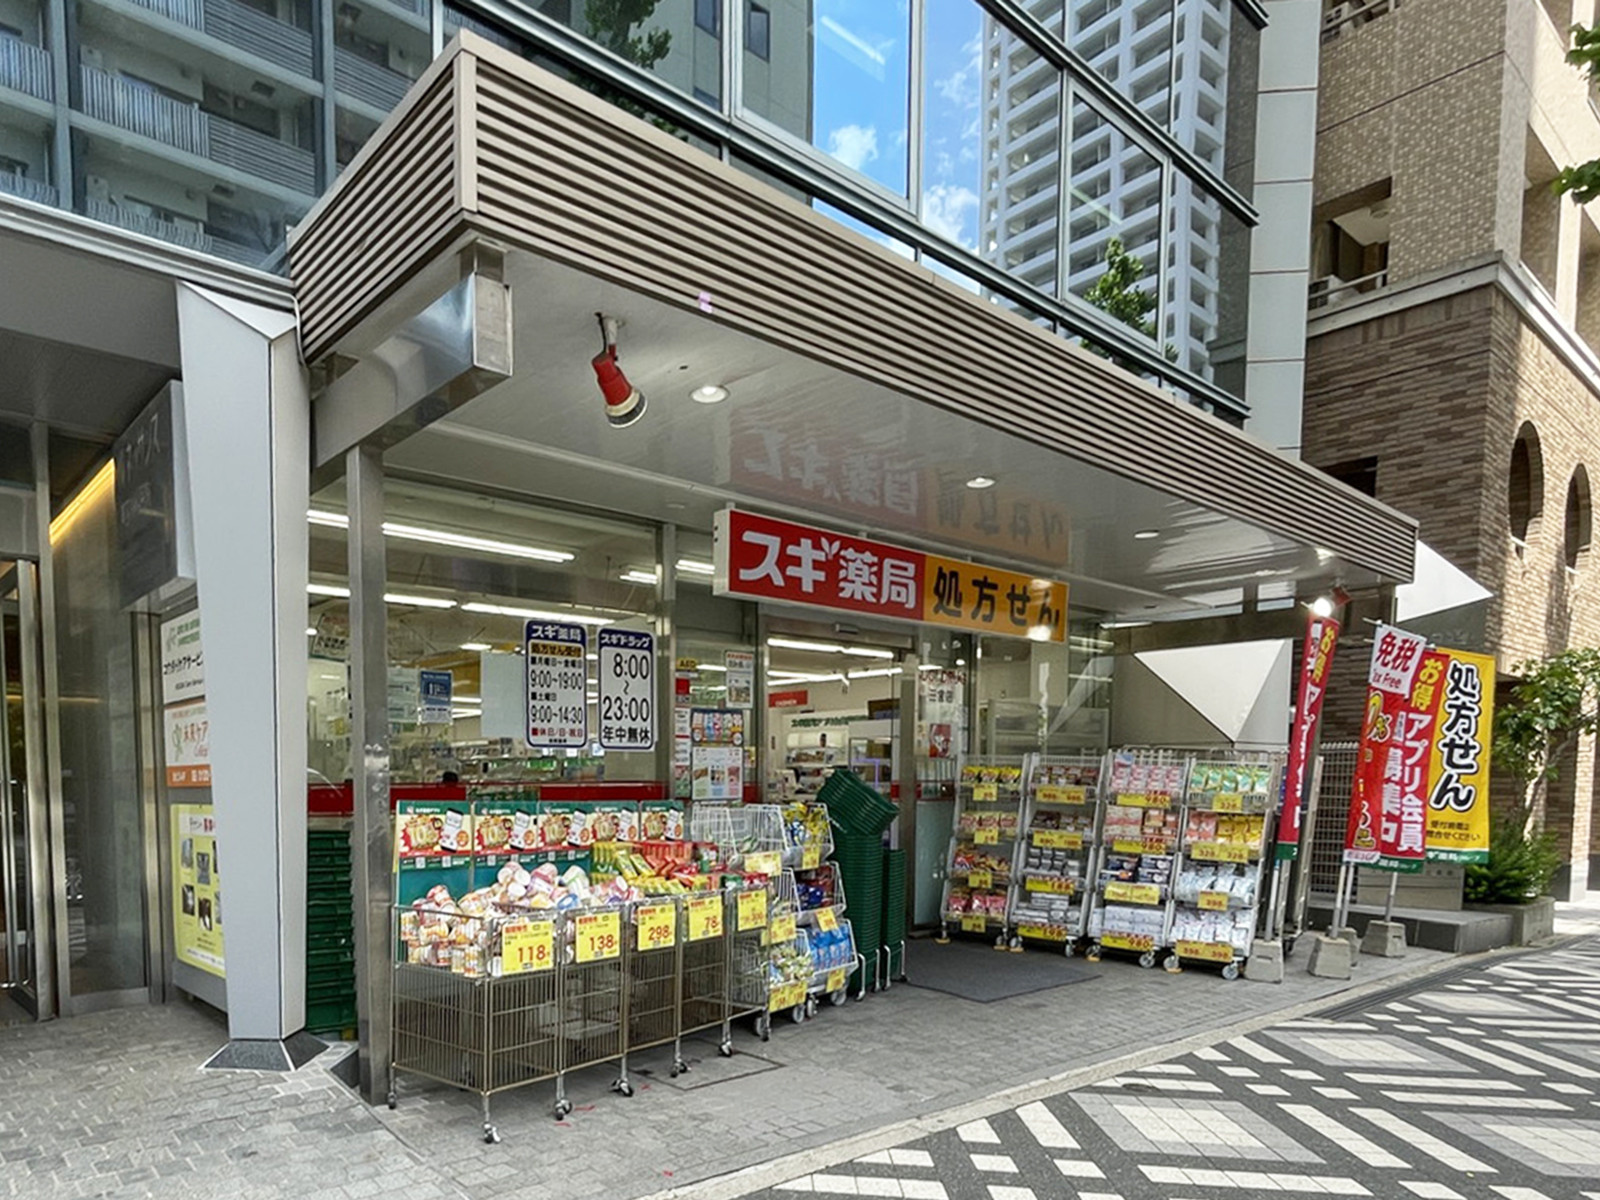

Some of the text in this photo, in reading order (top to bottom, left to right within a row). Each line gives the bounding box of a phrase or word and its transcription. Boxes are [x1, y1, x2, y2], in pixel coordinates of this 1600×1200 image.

[739, 530, 917, 610] スギ薬局
[933, 566, 1060, 630] 処方せん
[531, 624, 582, 641] スギ薬局
[601, 633, 650, 648] スギドラッグ
[613, 652, 649, 680] 8:00
[1375, 631, 1420, 673] 免税
[603, 695, 650, 722] 23:00
[603, 725, 650, 744] 年中無休
[1430, 660, 1481, 812] 処方せん
